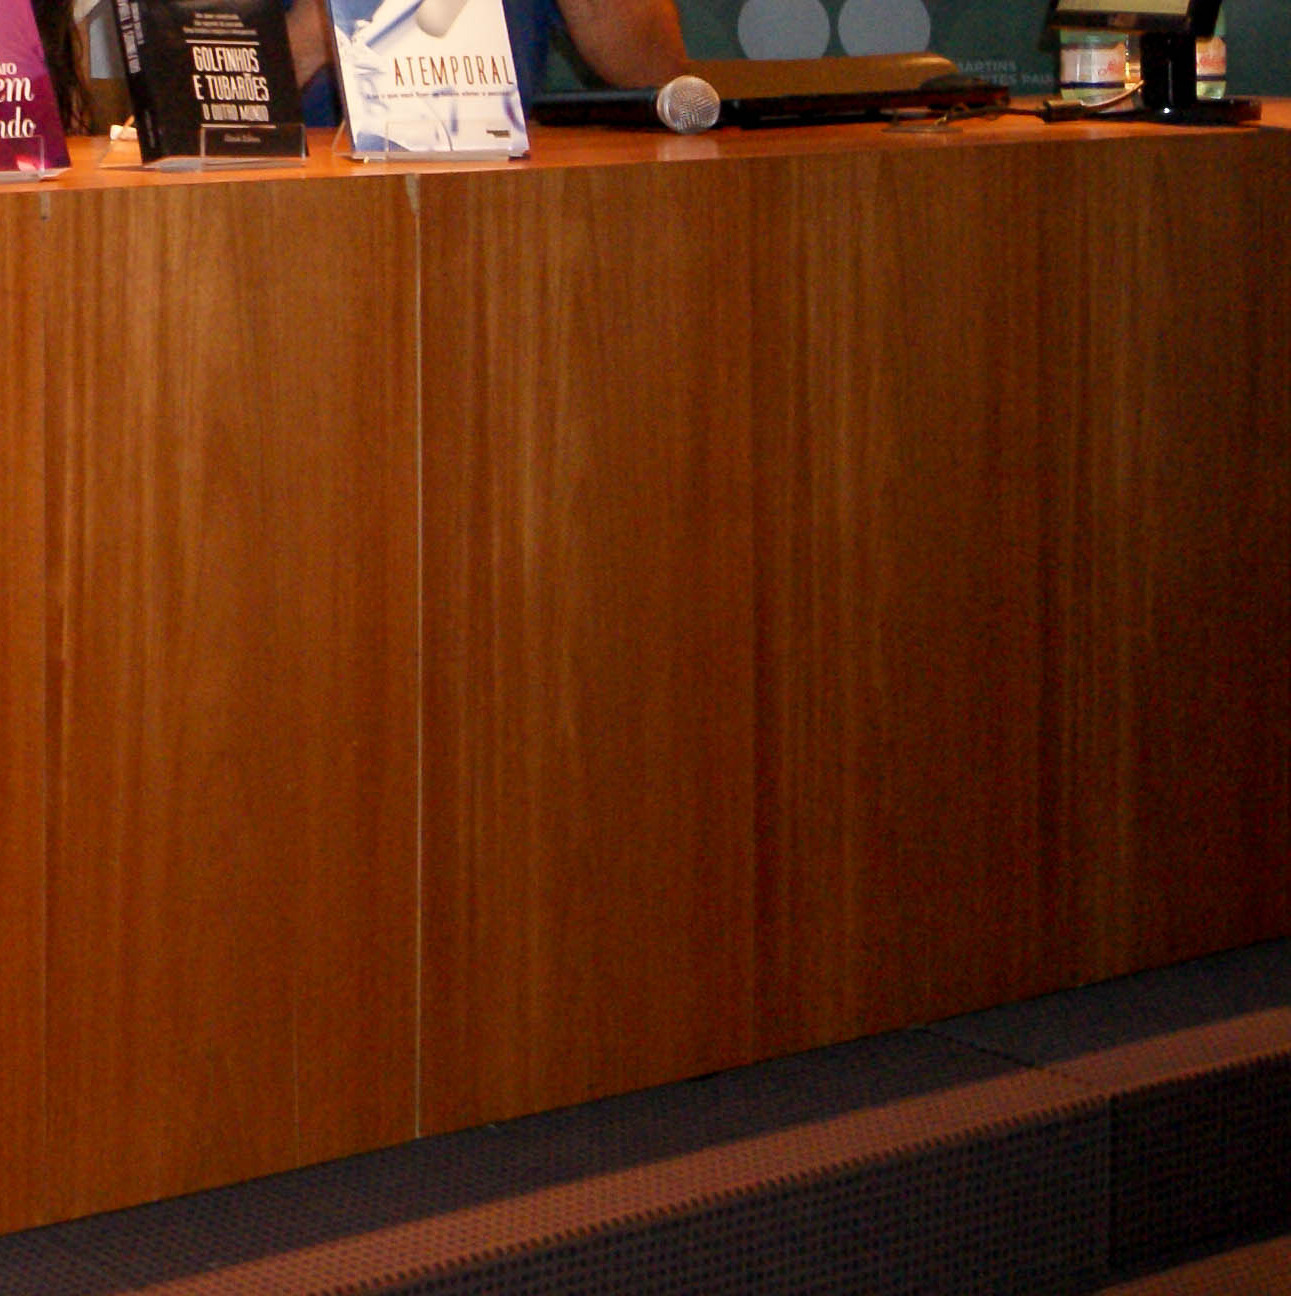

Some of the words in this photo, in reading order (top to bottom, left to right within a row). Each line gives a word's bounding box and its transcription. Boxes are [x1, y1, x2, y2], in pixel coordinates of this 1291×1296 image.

[192, 46, 260, 73] GOLFINHOS
[393, 55, 514, 87] ATEMPORAL
[193, 74, 204, 100] E
[205, 72, 270, 102] TUBARÕES
